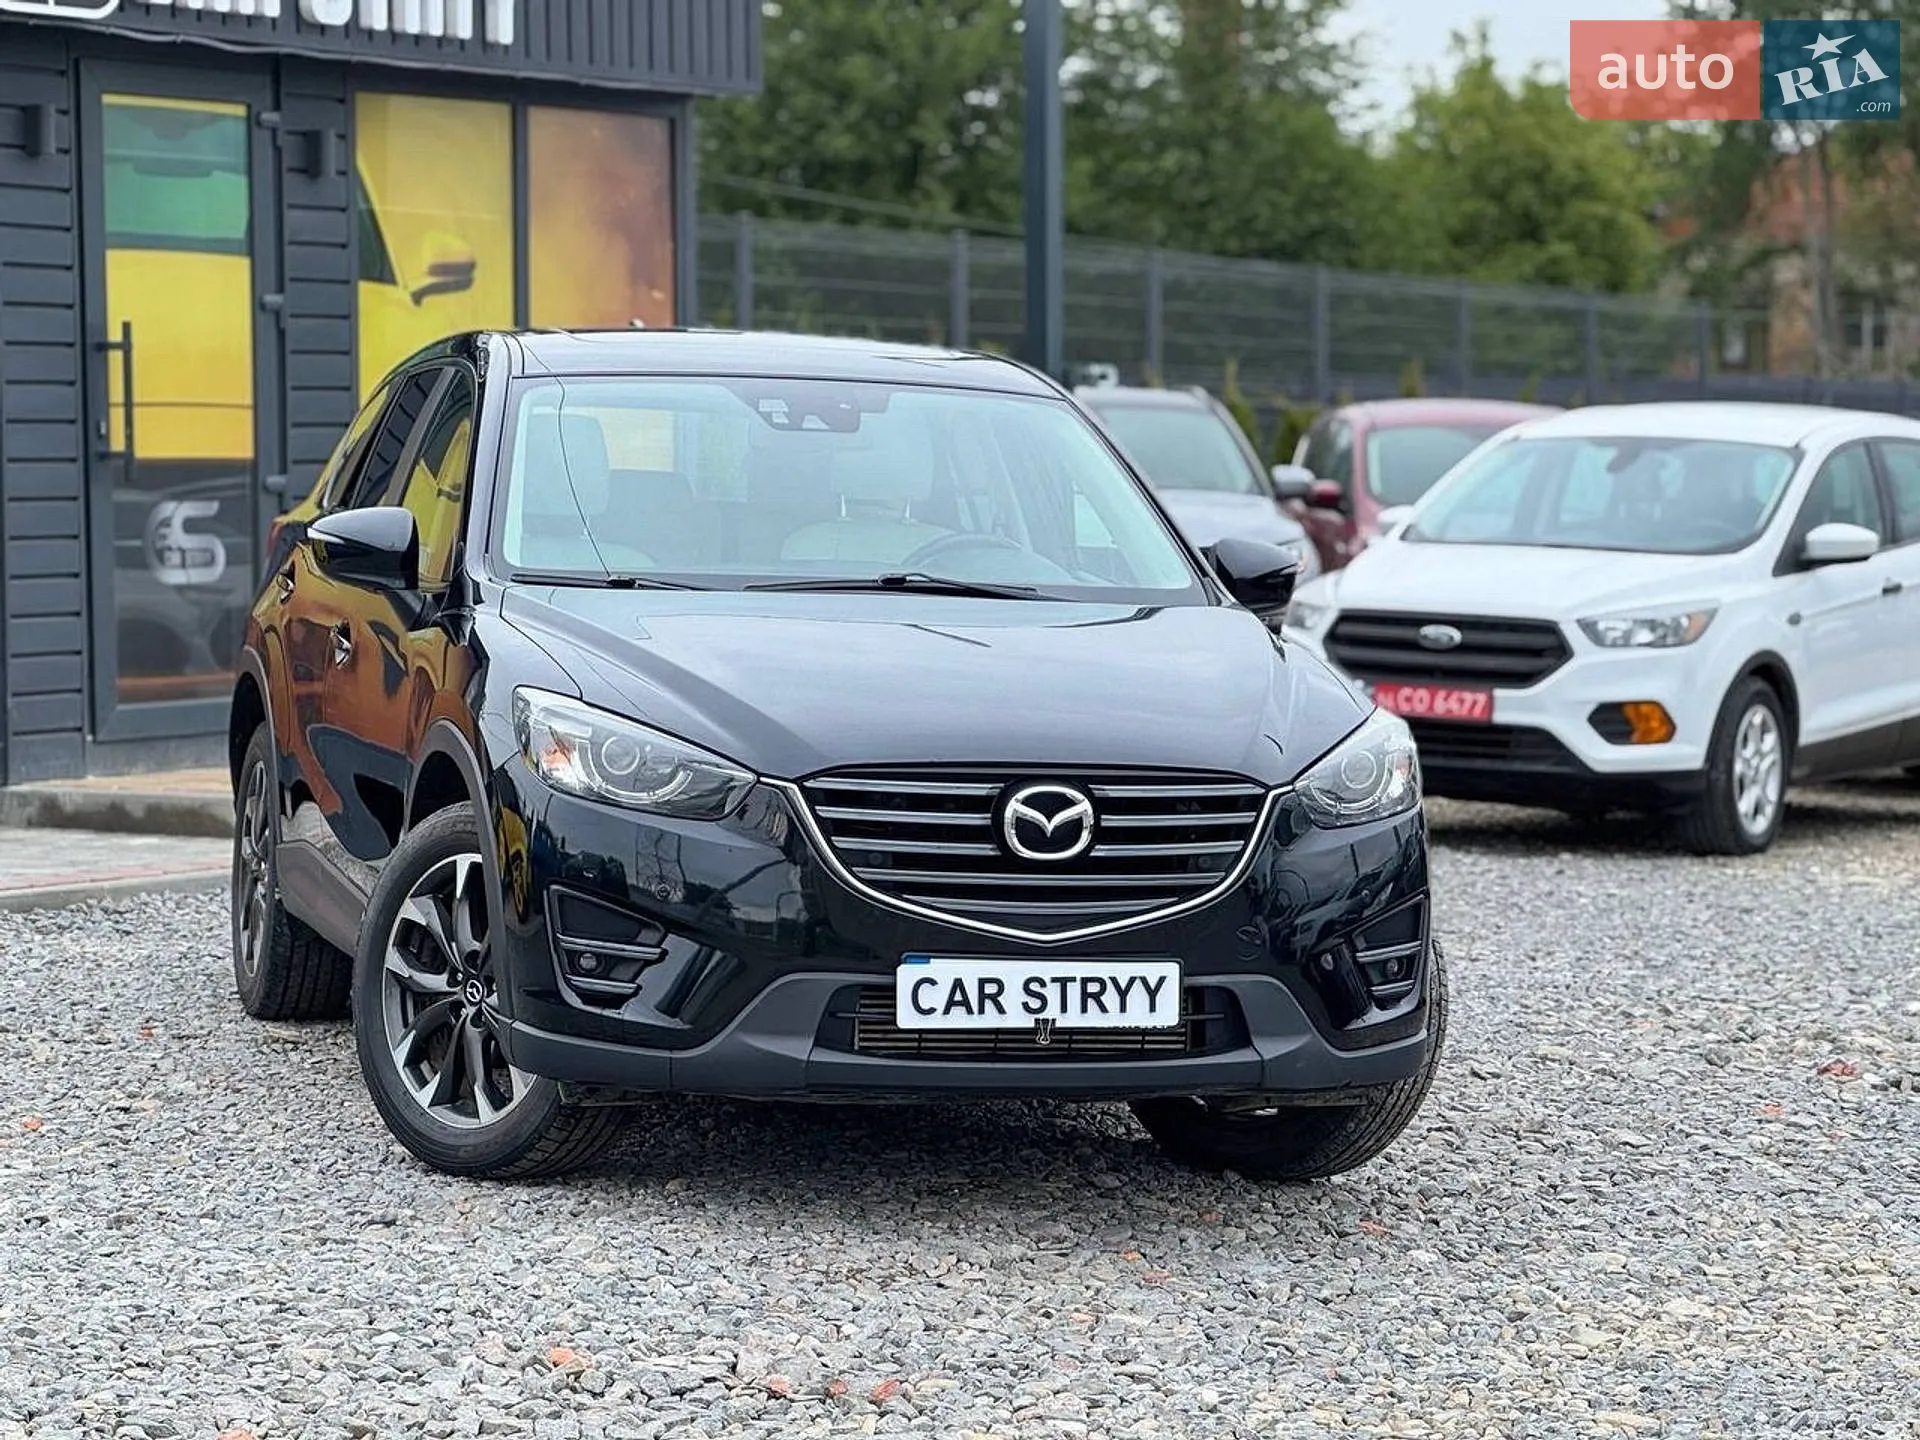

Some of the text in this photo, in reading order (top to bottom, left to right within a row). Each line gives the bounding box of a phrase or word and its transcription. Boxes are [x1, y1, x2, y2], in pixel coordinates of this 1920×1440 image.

[1433, 689, 1488, 717] 6477
[911, 975, 1167, 1016] CAR STRYY
